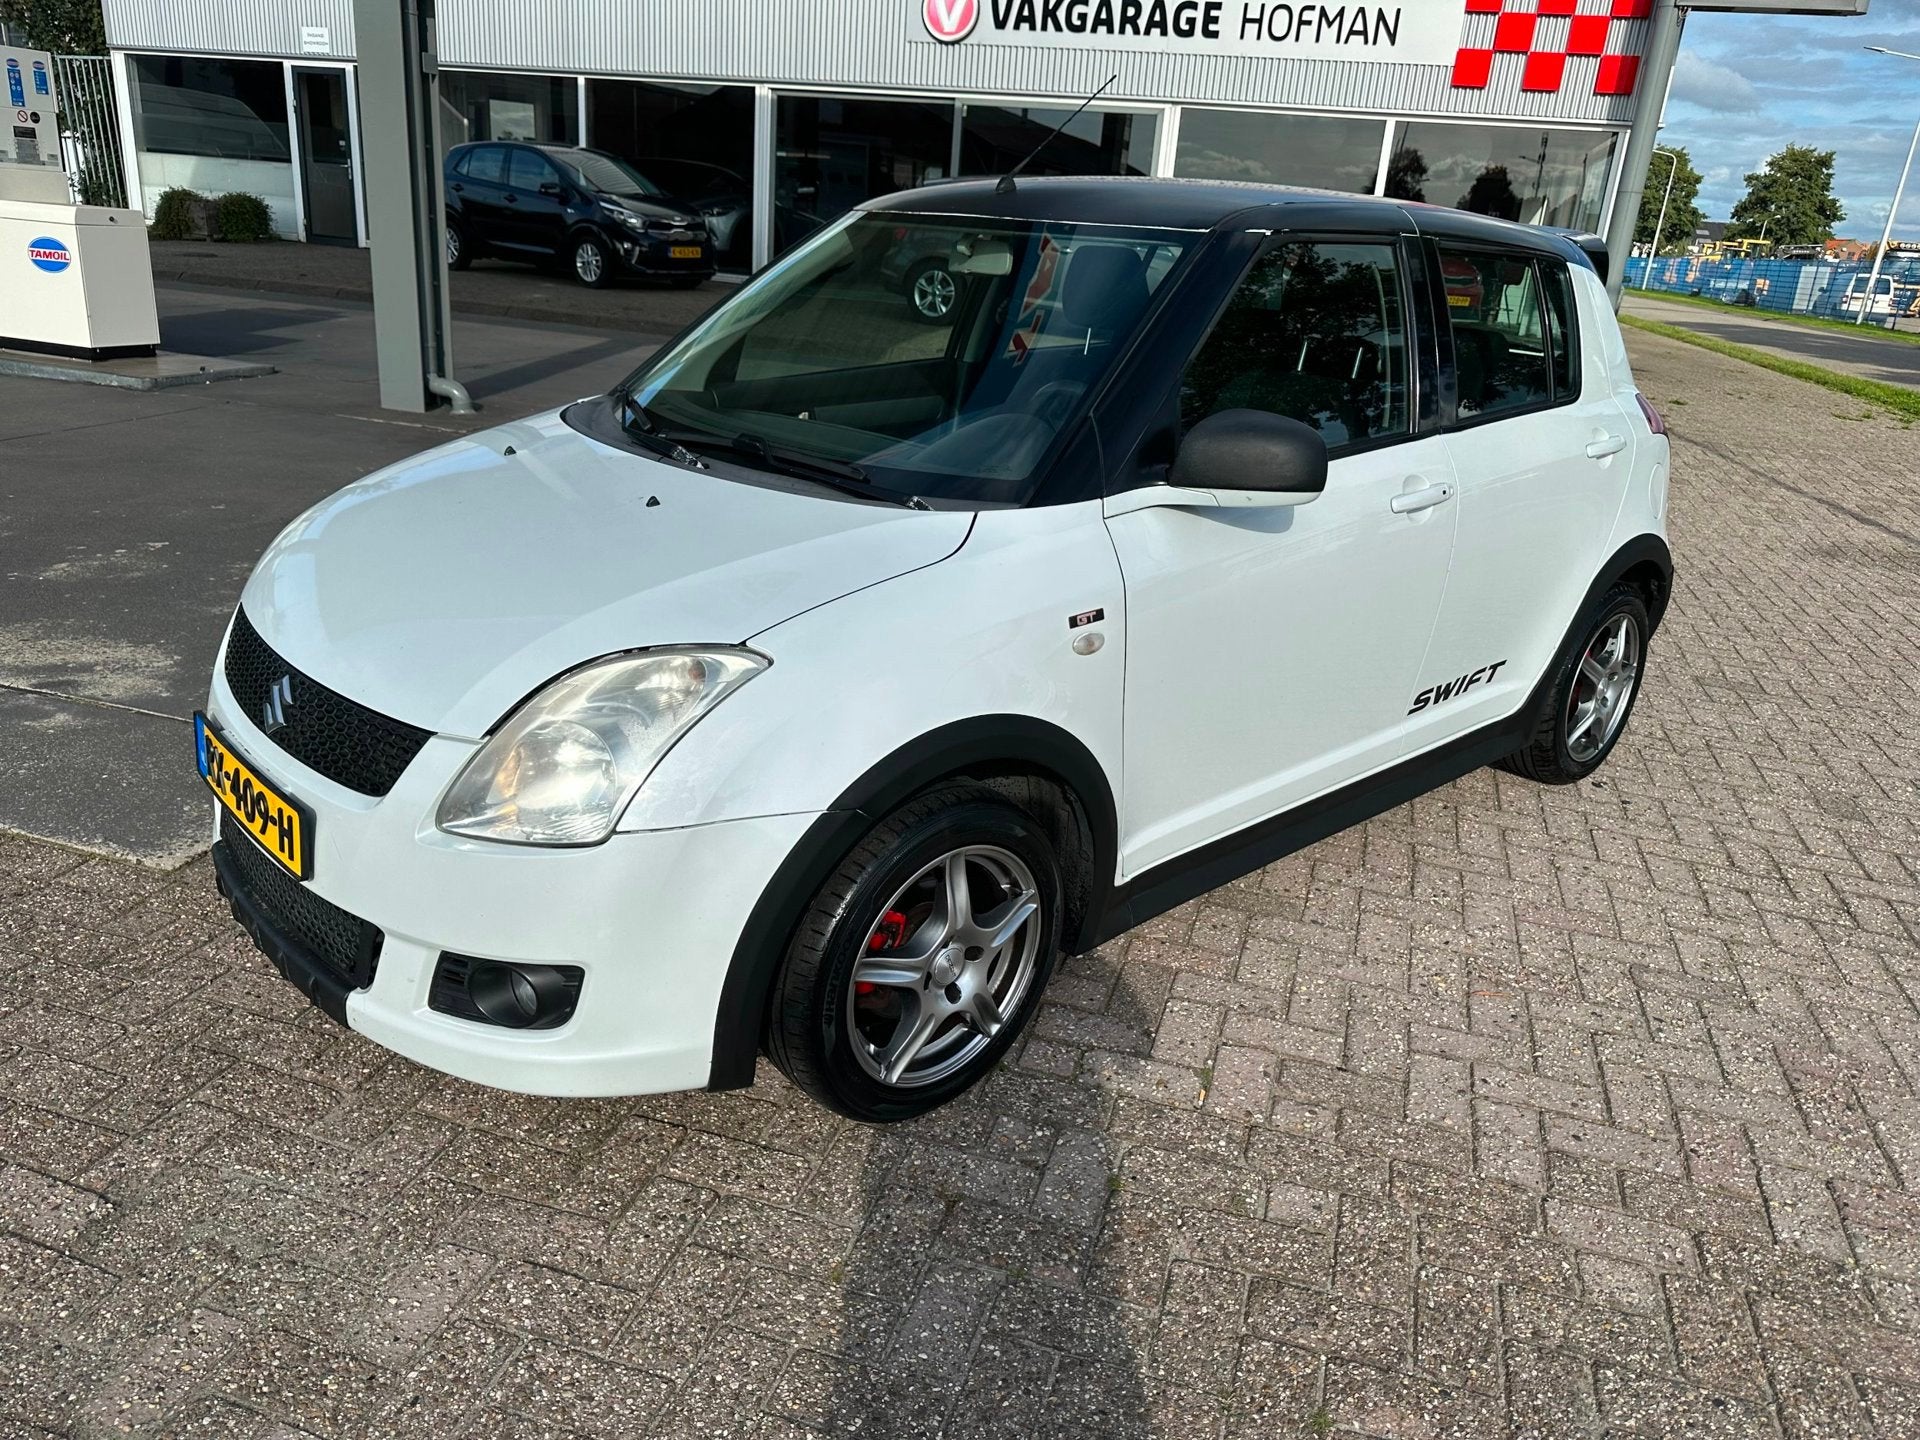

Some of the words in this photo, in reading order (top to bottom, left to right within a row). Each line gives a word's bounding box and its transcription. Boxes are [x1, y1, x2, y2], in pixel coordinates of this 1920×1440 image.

[991, 0, 1223, 39] VAKGARAGE
[1239, 2, 1402, 46] HOFMAN
[29, 250, 70, 261] TAMOIL
[1077, 611, 1097, 626] GT
[1406, 659, 1508, 716] SWIFT
